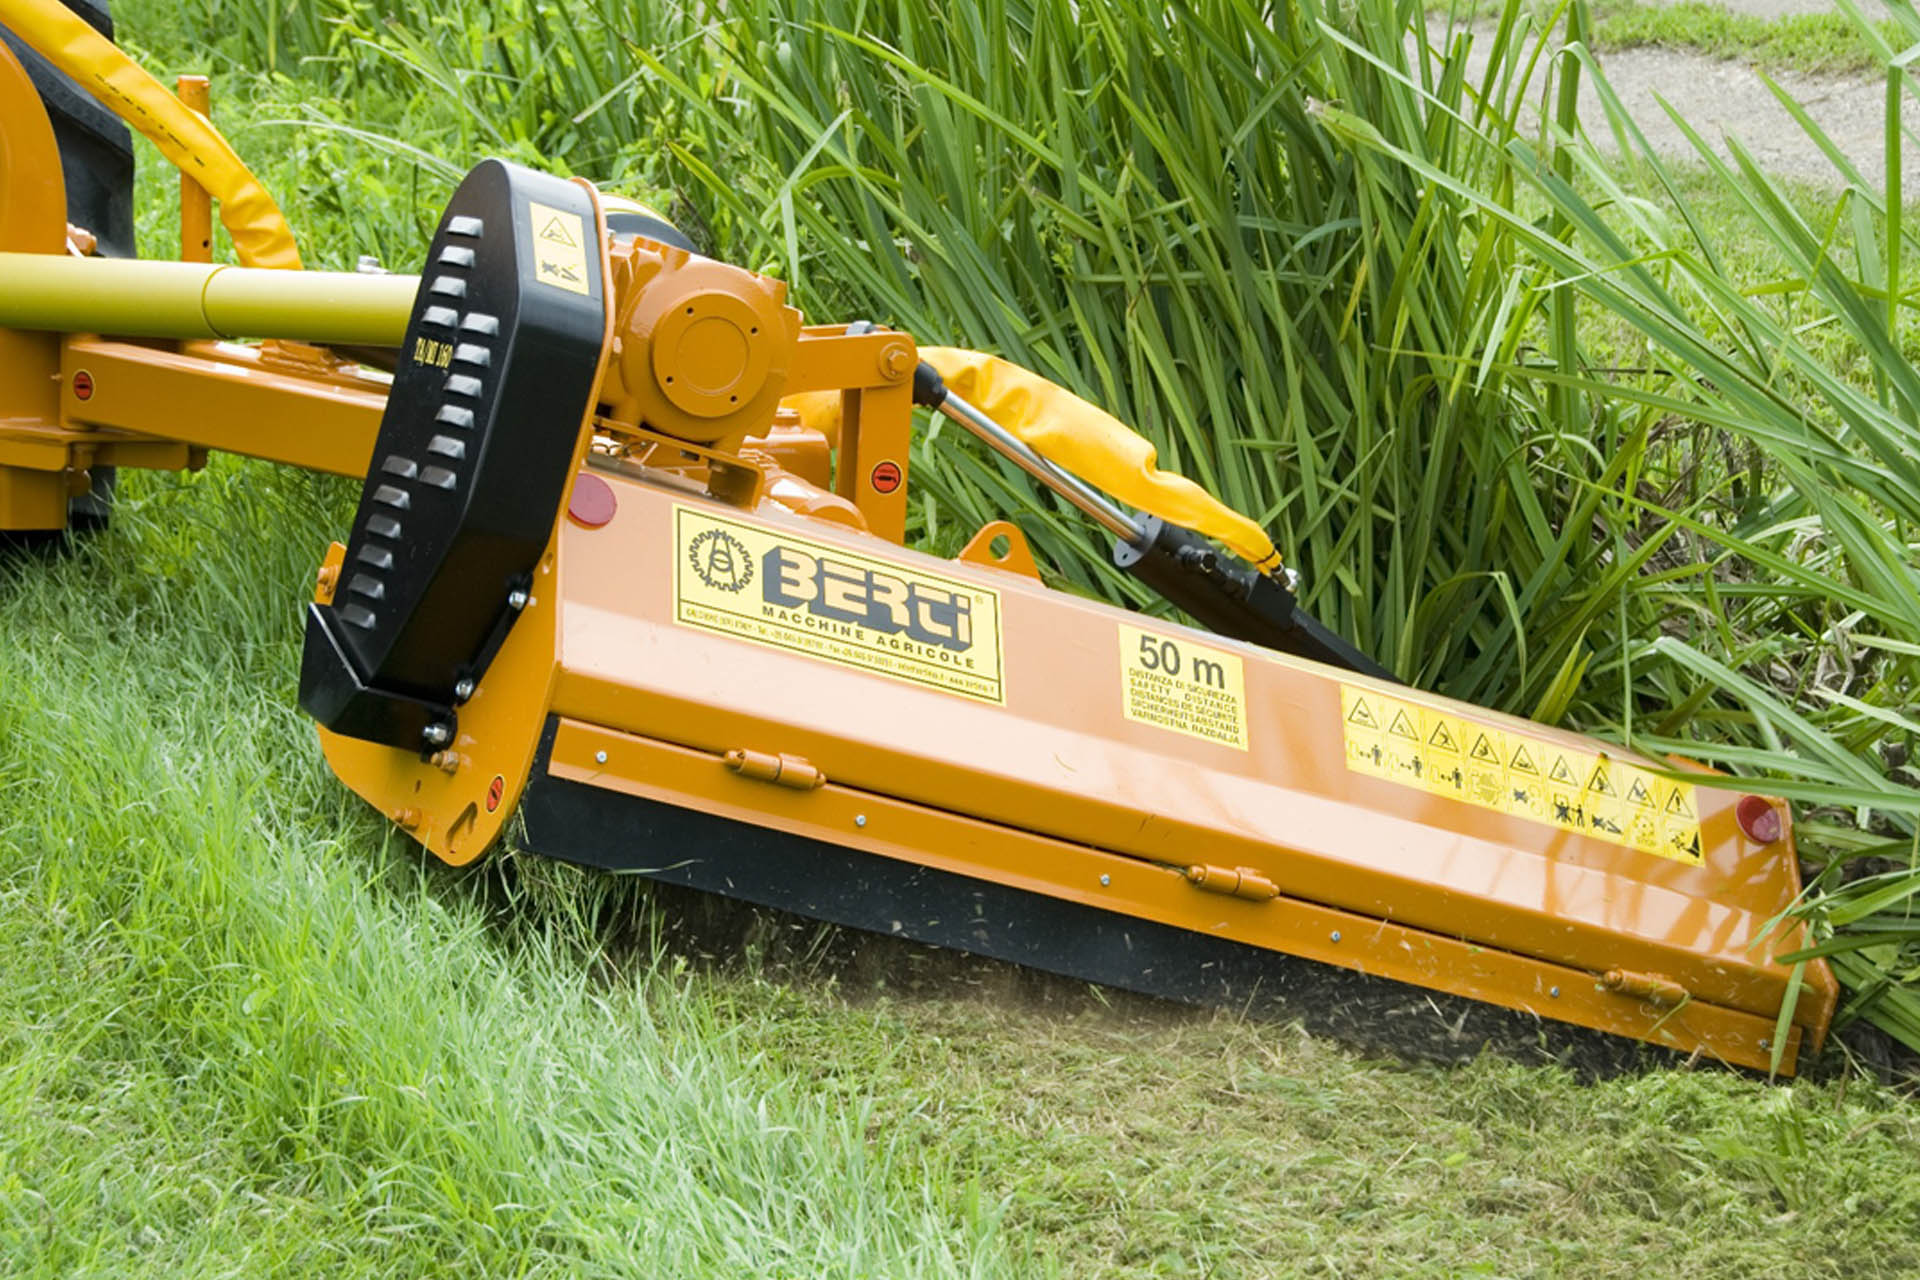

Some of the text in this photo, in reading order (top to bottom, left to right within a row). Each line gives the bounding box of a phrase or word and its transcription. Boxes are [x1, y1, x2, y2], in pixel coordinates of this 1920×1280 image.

[762, 605, 865, 641] MACCHINE
[876, 635, 975, 669] AGRICOLE
[1139, 634, 1225, 689] 50 m
[1129, 677, 1238, 714] SAFETY DISTANCE
